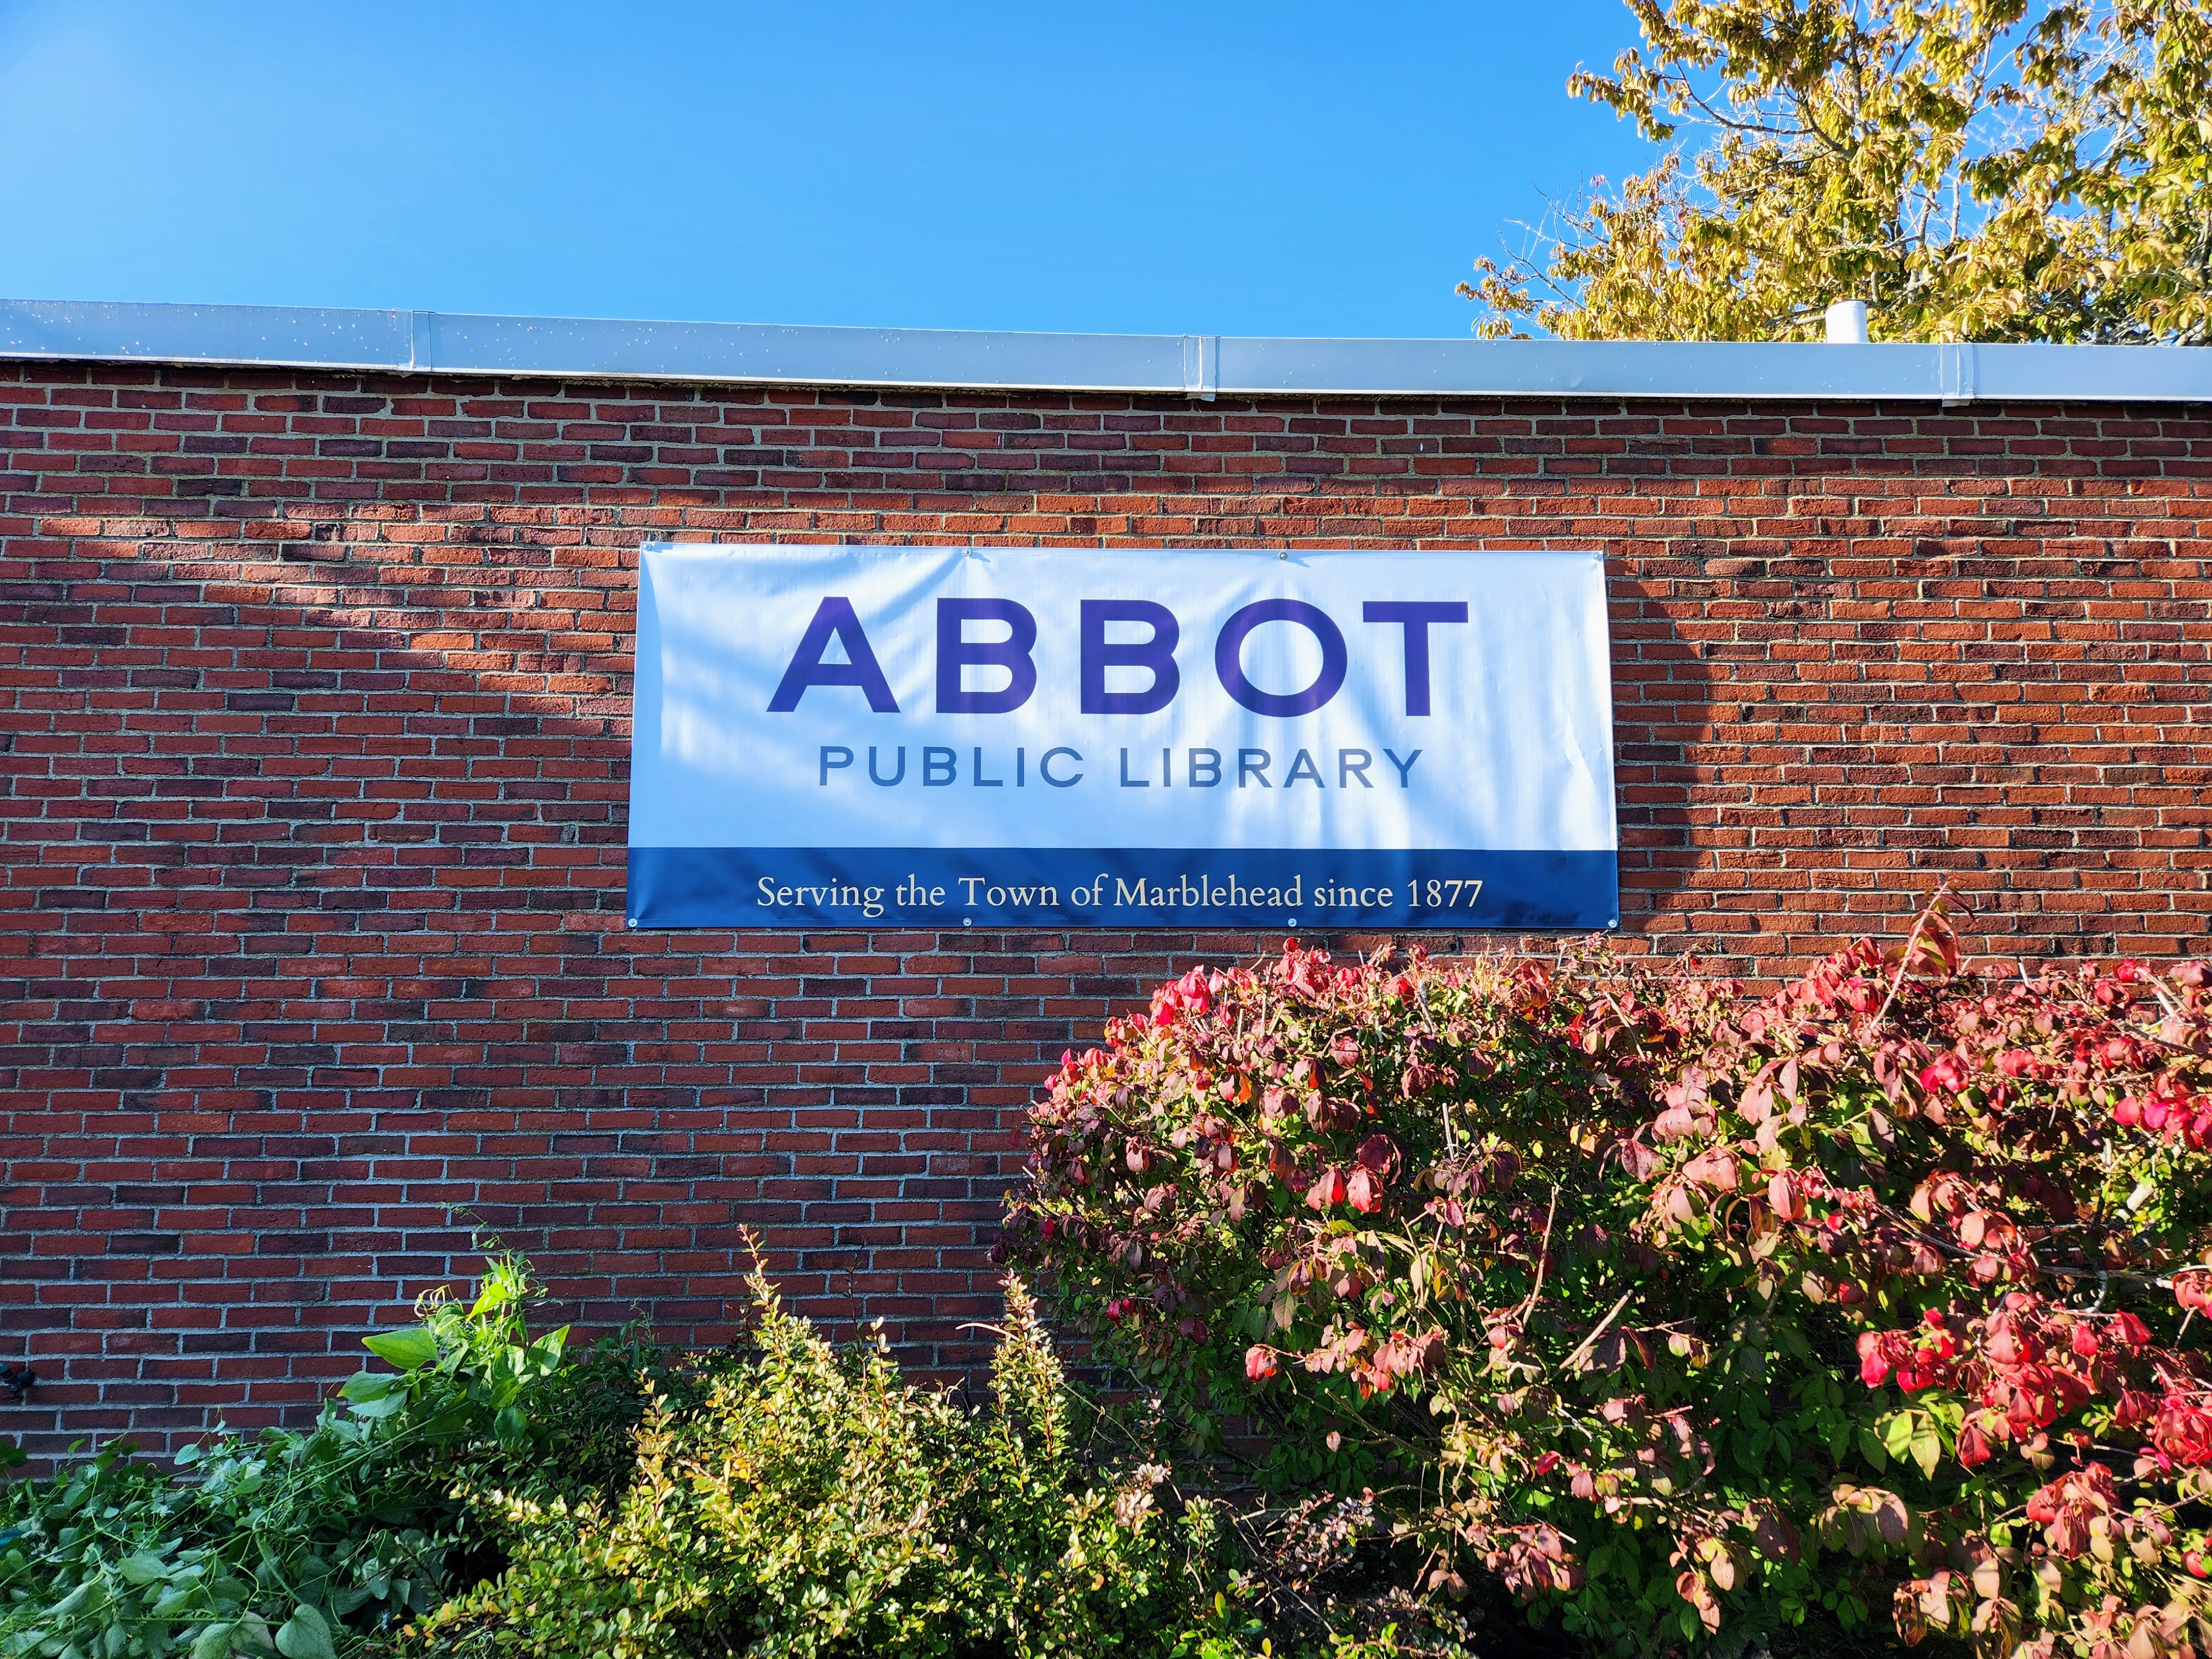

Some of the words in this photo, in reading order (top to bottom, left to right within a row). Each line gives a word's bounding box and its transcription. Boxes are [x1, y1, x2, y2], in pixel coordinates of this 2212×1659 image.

[766, 596, 1469, 718] ABBOT
[820, 745, 1084, 788] PUBLIC
[1120, 748, 1423, 789] LIBRARY
[758, 876, 885, 918] Serving
[895, 873, 946, 906] the
[958, 877, 1060, 906] Town
[1071, 873, 1110, 906] of
[1113, 874, 1303, 907] Marblehead
[1314, 878, 1393, 907] since
[1407, 879, 1483, 907] 1877
